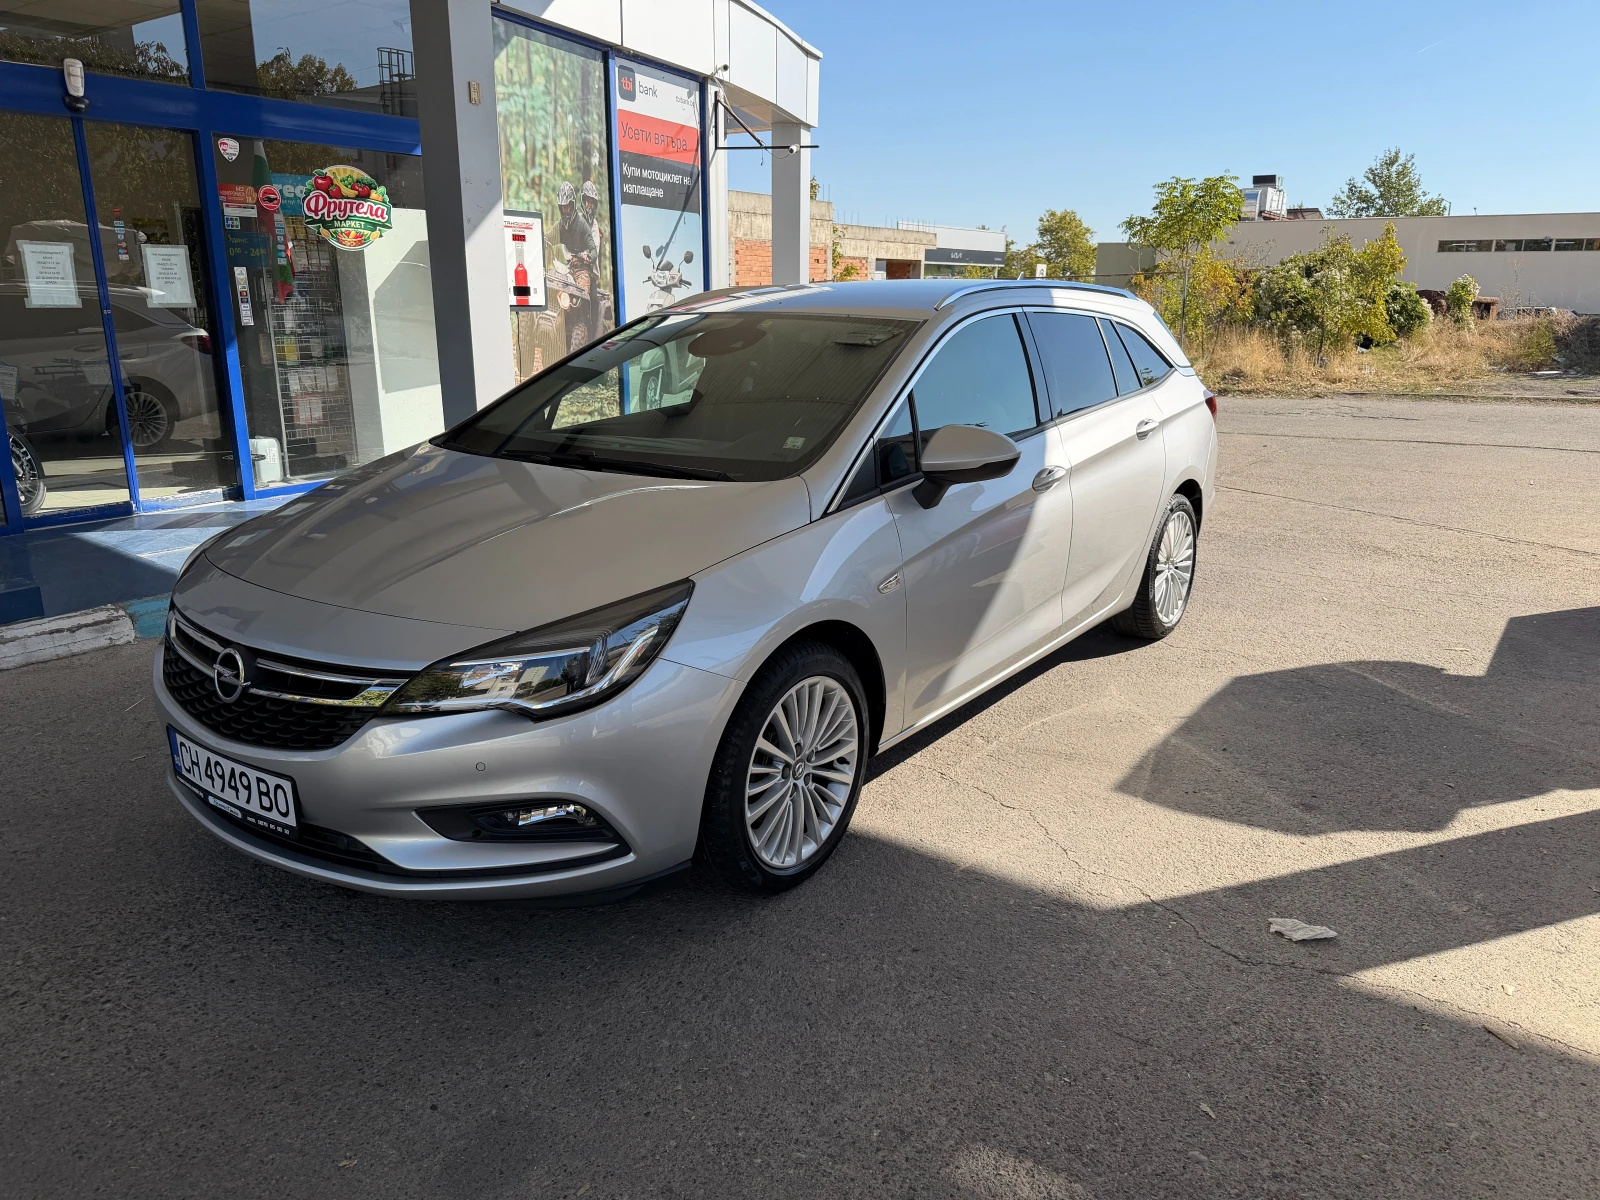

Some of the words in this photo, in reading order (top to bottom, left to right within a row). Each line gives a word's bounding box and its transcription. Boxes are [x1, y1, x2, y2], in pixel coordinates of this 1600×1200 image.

[621, 77, 633, 92] tbi
[638, 81, 658, 98] bank
[621, 122, 652, 143] Усети
[654, 133, 687, 153] вятъра
[622, 163, 640, 179] Купи
[641, 169, 682, 185] мотоциклет
[683, 176, 692, 186] на
[623, 183, 664, 198] изплащане
[305, 193, 387, 220] Фрутела
[334, 220, 366, 229] МАРКЕТ
